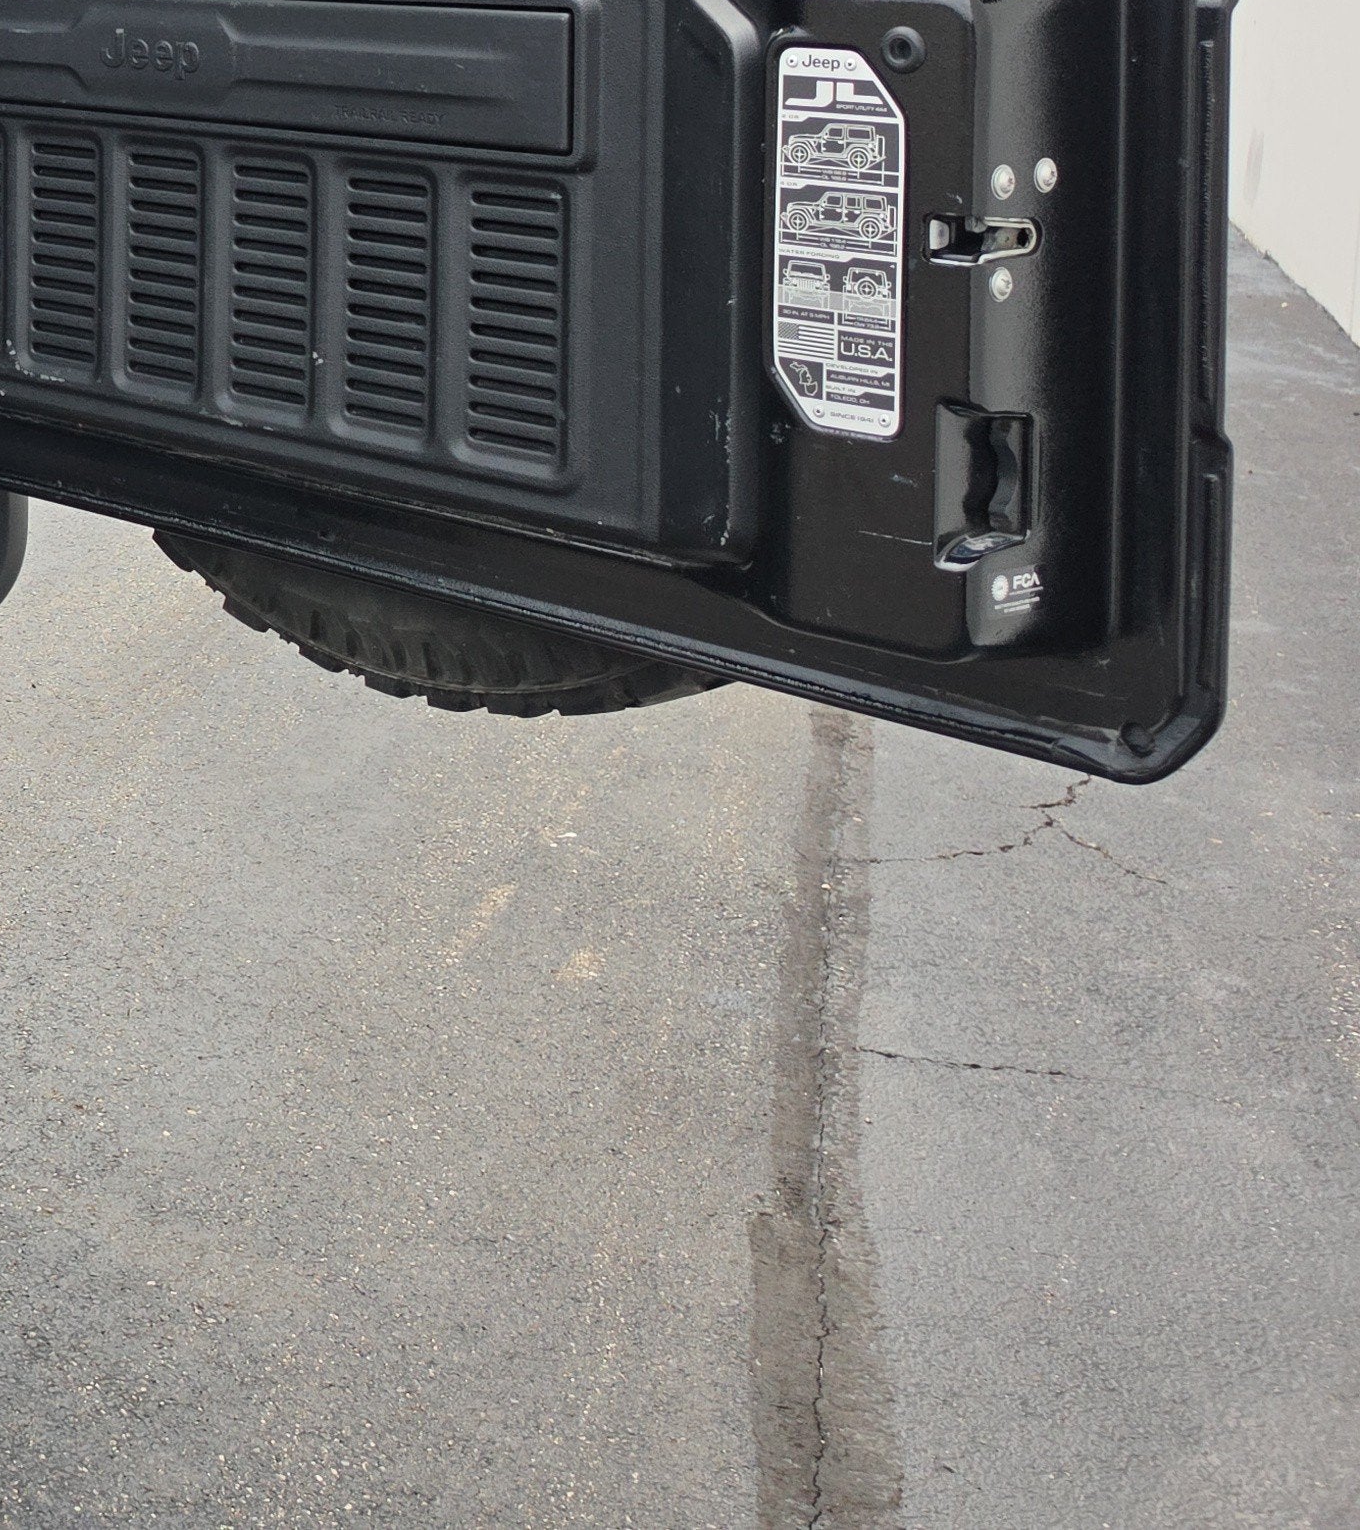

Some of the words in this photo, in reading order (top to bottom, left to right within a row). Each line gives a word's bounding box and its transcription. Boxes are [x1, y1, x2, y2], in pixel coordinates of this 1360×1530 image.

[101, 28, 200, 81] Jeep
[801, 54, 841, 72] Jeep
[784, 80, 884, 108] JL
[779, 248, 805, 256] WATER
[806, 251, 840, 259] FORDING
[840, 335, 865, 344] MADE
[877, 340, 893, 348] THE
[840, 341, 893, 362] U.S.A.
[825, 362, 869, 373] DEVELOPED
[830, 373, 859, 383] AUBURN
[830, 411, 856, 421] SINCE
[857, 415, 874, 424] 1941
[1012, 571, 1040, 590] FCA
